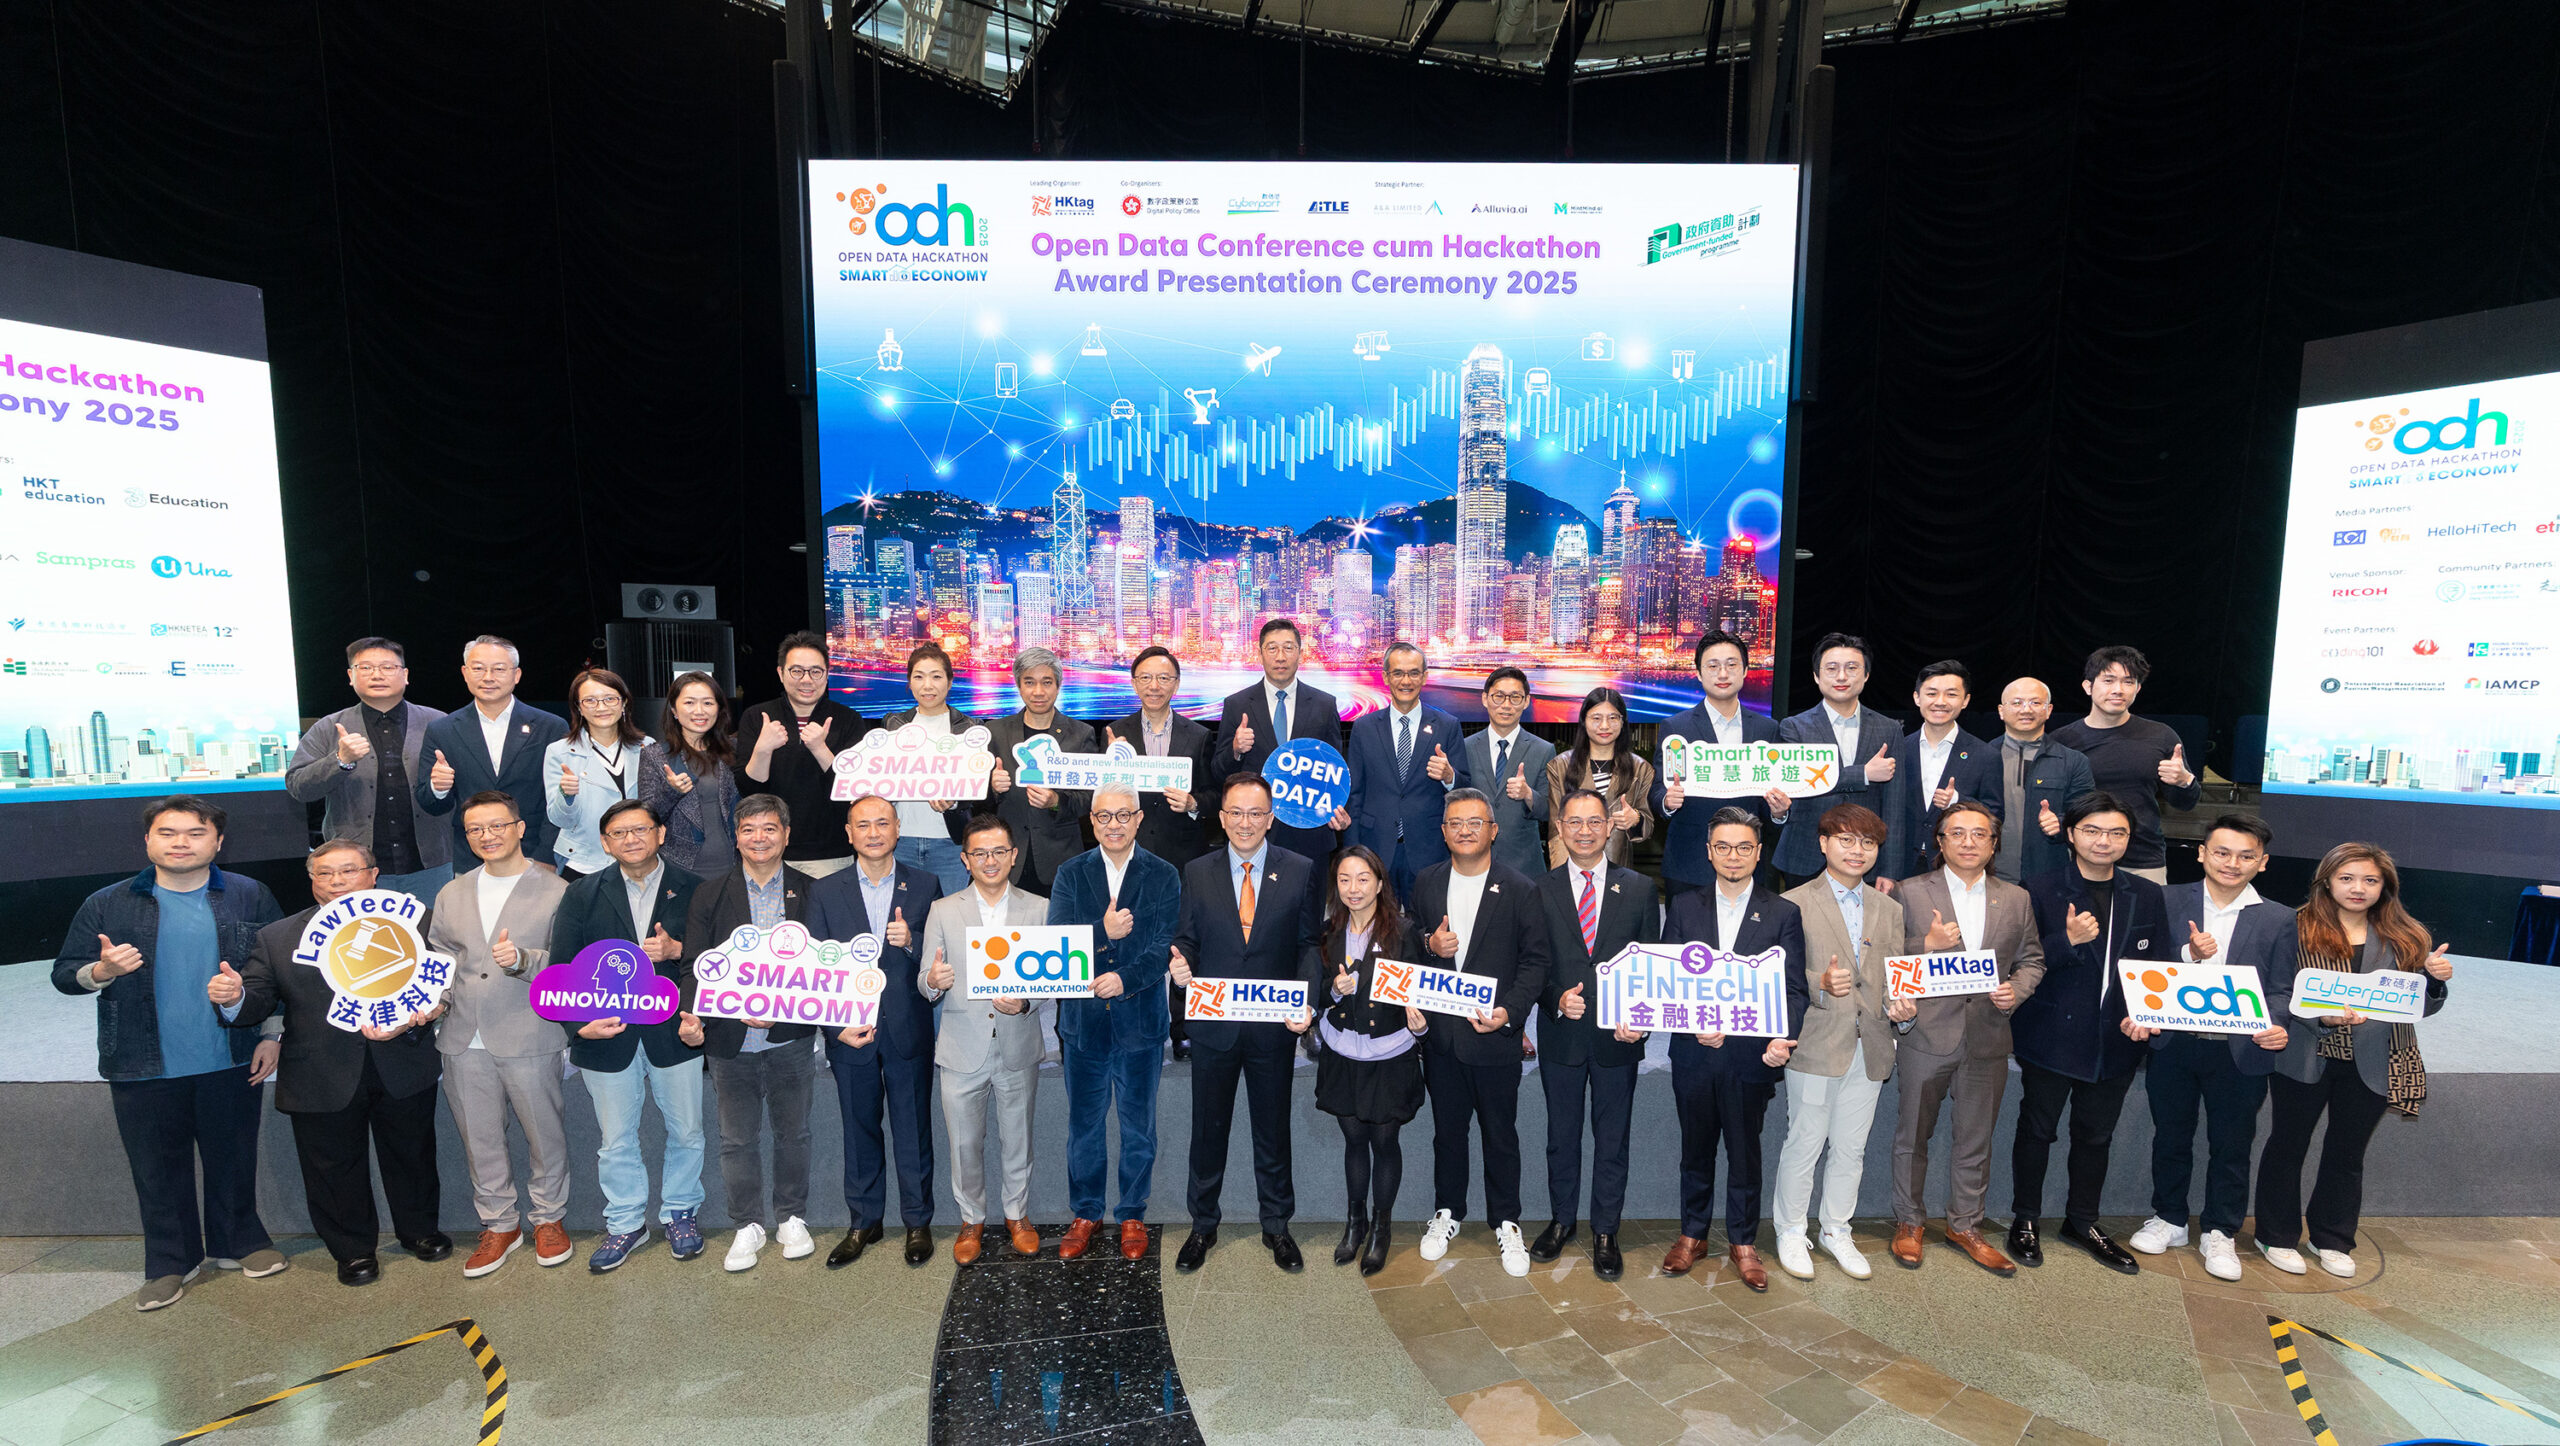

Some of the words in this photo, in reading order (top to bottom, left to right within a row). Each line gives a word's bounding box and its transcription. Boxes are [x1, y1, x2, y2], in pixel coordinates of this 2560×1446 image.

[1030, 180, 1052, 188] Leading
[1374, 181, 1400, 189] Strategic
[1055, 196, 1094, 210] HKtag
[1147, 207, 1164, 216] Digital
[1165, 207, 1182, 216] Policy
[1183, 207, 1200, 215] Office
[1228, 196, 1280, 210] Cyberport
[1483, 204, 1528, 214] Alluvia.ai
[875, 183, 974, 246] odh
[978, 218, 989, 247] 2025
[1685, 213, 1735, 240] 政府資助
[1737, 212, 1761, 232] 計劃
[1031, 232, 1108, 261] Open
[1119, 232, 1189, 258] Data
[1197, 232, 1365, 258] Conference
[1373, 239, 1433, 259] cum
[1443, 233, 1601, 259] Hackathon
[1662, 231, 1734, 259] Government-funded
[1699, 238, 1740, 257] programme
[838, 251, 874, 263] OPEN
[877, 251, 908, 263] DATA
[911, 251, 989, 263] HACKATHON
[839, 268, 889, 282] SMART
[911, 268, 989, 282] ECONOMY
[1054, 268, 1151, 293] Award
[1158, 268, 1343, 294] Presentation
[1351, 269, 1499, 300] Ceremony
[1506, 270, 1578, 295] 2025
[85, 399, 180, 432] 2025
[2394, 397, 2509, 455] odh
[2349, 463, 2386, 475] OPEN
[2391, 458, 2426, 470] DATA
[2431, 448, 2523, 466] HACKATHON
[23, 476, 60, 490] HKT
[2349, 474, 2402, 489] SMART
[2428, 463, 2520, 482] ECONOMY
[25, 489, 105, 506] education
[149, 493, 229, 510] Education
[2335, 507, 2367, 518] Media
[2427, 520, 2517, 538] HelloHiTech
[36, 551, 136, 570] Sampras
[184, 561, 233, 578] Una
[2438, 564, 2501, 575] Community
[2329, 569, 2360, 579] Venue
[2363, 568, 2407, 579] Sponsor:
[2332, 587, 2388, 598] RICOH
[2324, 626, 2351, 635] Event
[2485, 679, 2541, 690] IAMCP
[1047, 756, 1070, 766] R&D
[1072, 757, 1090, 767] and
[1092, 760, 1112, 768] new
[1114, 758, 1190, 770] industrialisation
[1693, 745, 1752, 762] Smart
[867, 755, 964, 775] SMART
[1277, 751, 1344, 786] OPEN
[1693, 763, 1801, 783] 智慧旅遊
[834, 777, 986, 799] ECONOMY
[1047, 770, 1189, 790] 研發及新型工業化
[1271, 778, 1333, 814] DATA
[296, 896, 417, 963] LawTech
[1014, 936, 1089, 981] odh
[1928, 954, 1996, 979] HKtag
[736, 961, 850, 994] SMART
[1418, 970, 1494, 1005] HKtag
[1627, 957, 1760, 1003] FINTECH
[2377, 974, 2420, 993] 數碼港
[330, 957, 451, 1029] 法律科技
[972, 985, 1000, 995] OPEN
[1002, 985, 1027, 994] DATA
[1029, 984, 1089, 994] HACKATHON
[1232, 983, 1305, 1008] HKtag
[2176, 974, 2264, 1019] odh
[2304, 975, 2421, 1009] Cyberport
[539, 990, 670, 1012] INNOVATION
[697, 988, 876, 1026] ECONOMY
[1628, 1000, 1760, 1034] 金融科技
[2135, 1013, 2166, 1025] OPEN
[2167, 1015, 2197, 1027] DATA
[2198, 1018, 2268, 1031] HACKATHON
